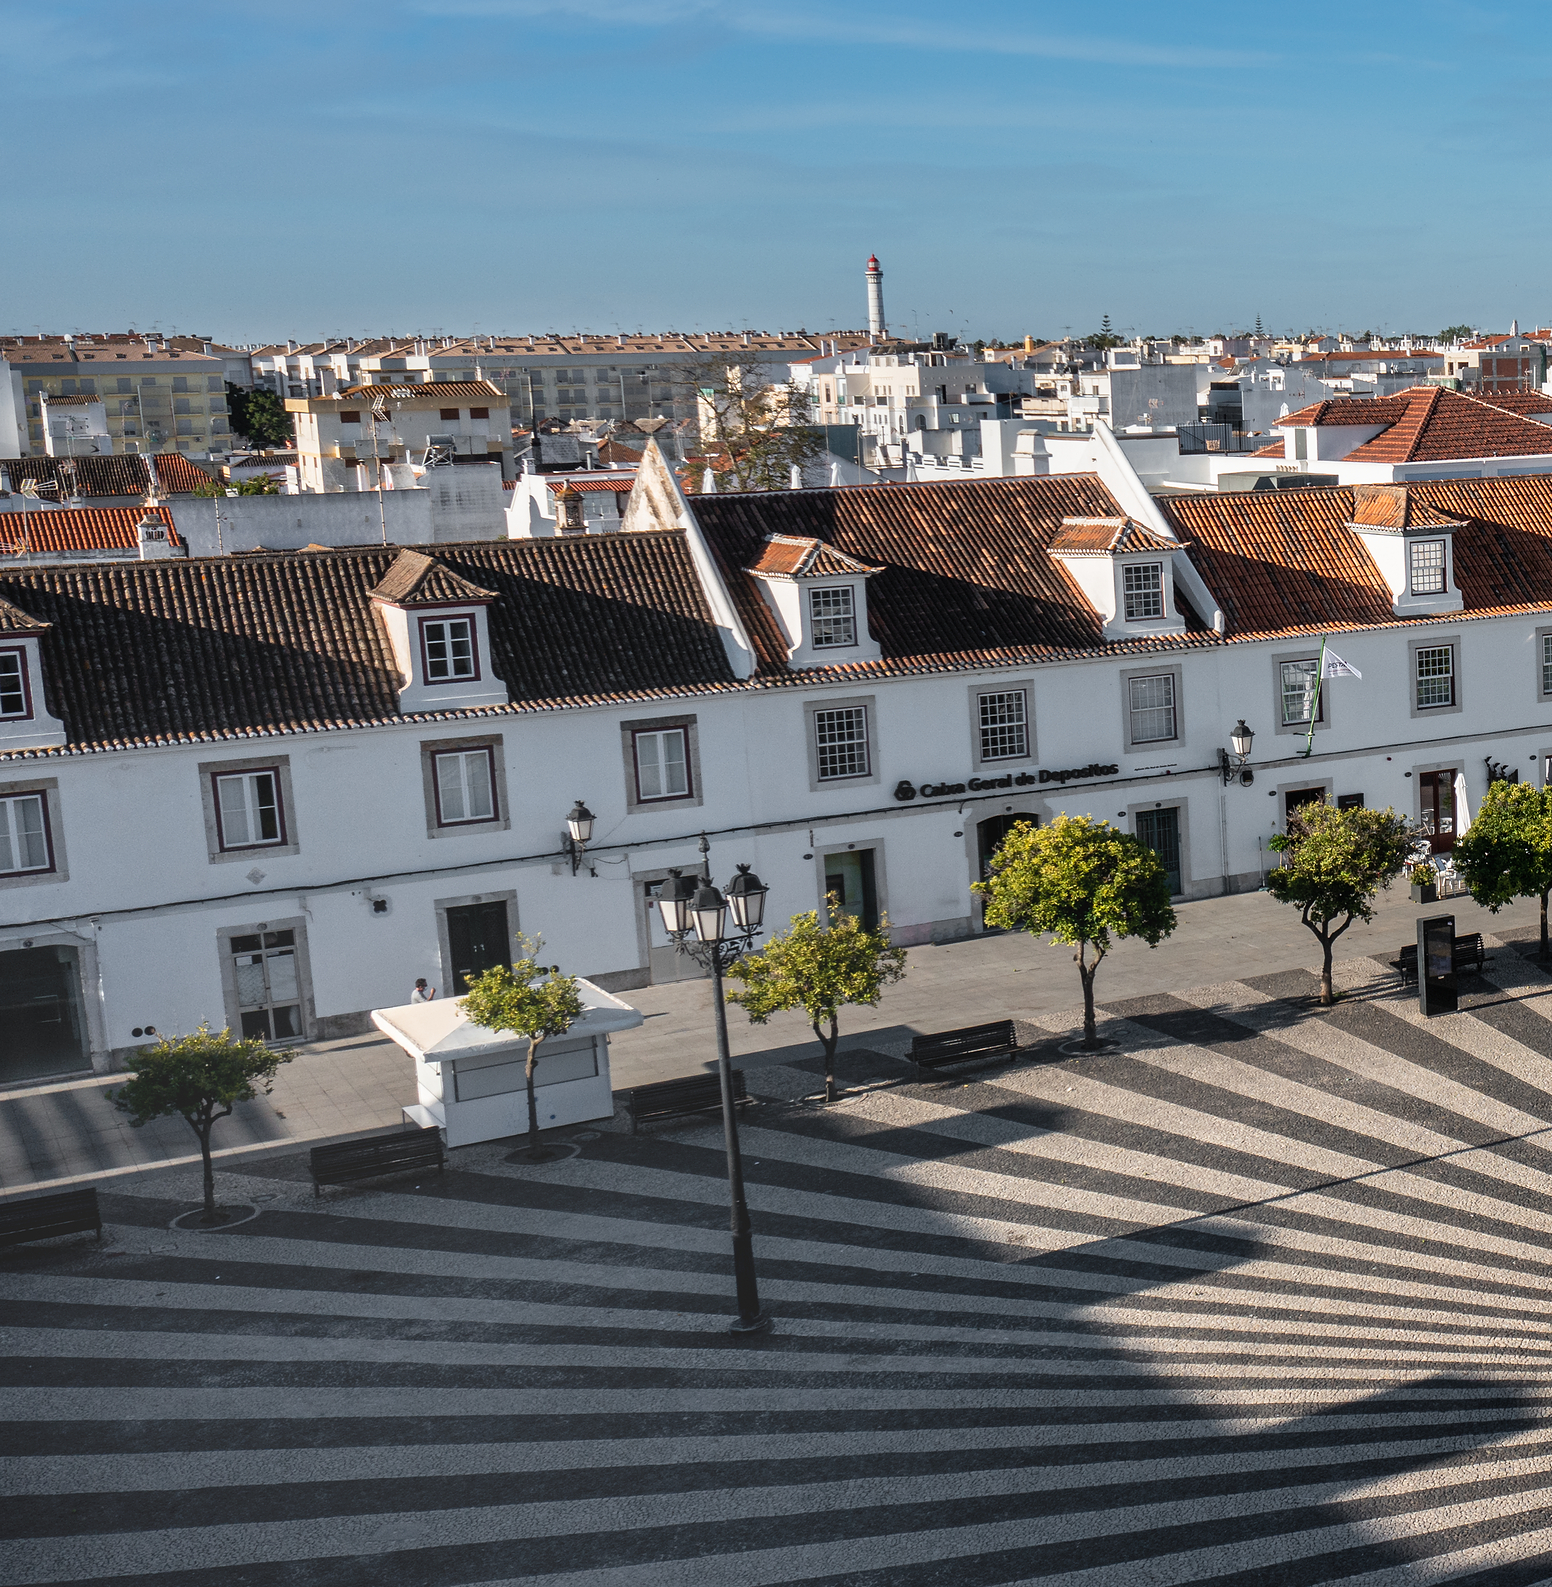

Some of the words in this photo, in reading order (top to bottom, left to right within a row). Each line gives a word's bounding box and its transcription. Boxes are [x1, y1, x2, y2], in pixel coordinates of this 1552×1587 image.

[920, 781, 966, 799] Caixa
[968, 774, 1013, 791] Geral
[1015, 772, 1036, 787] de
[1038, 762, 1119, 785] Depositos
